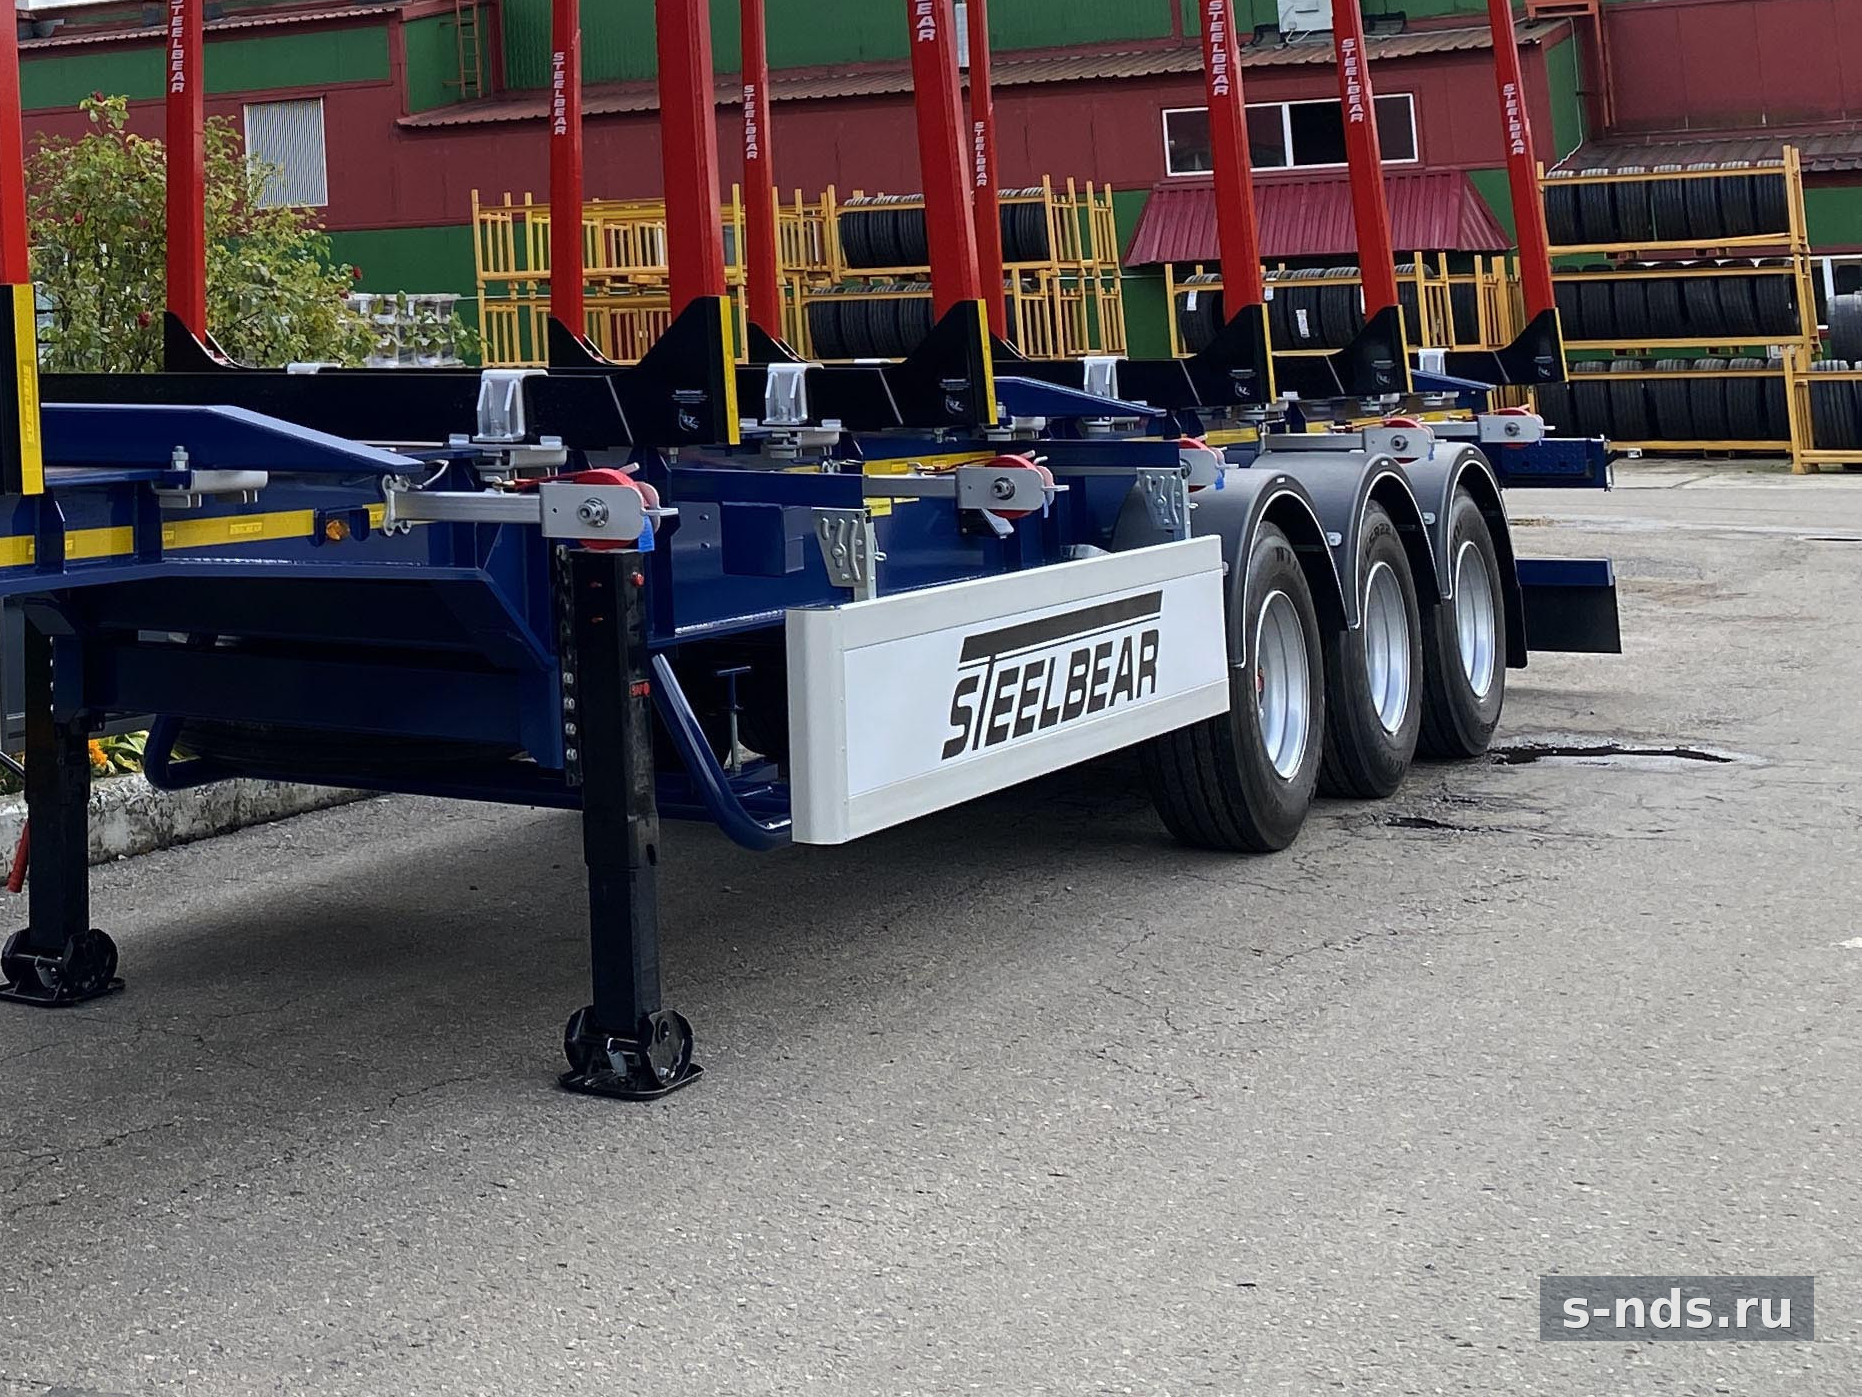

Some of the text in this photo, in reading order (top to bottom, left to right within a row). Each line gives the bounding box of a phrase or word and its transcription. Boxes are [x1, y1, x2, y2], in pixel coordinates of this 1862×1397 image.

[1208, 0, 1230, 96] STEELBEAR
[1341, 37, 1365, 123] STEELBEAR
[552, 51, 567, 135] STEELBEAR
[744, 84, 758, 160] STEELBEAR
[1503, 83, 1525, 156] STEELBEAR
[940, 590, 1163, 760] STEELBEAR
